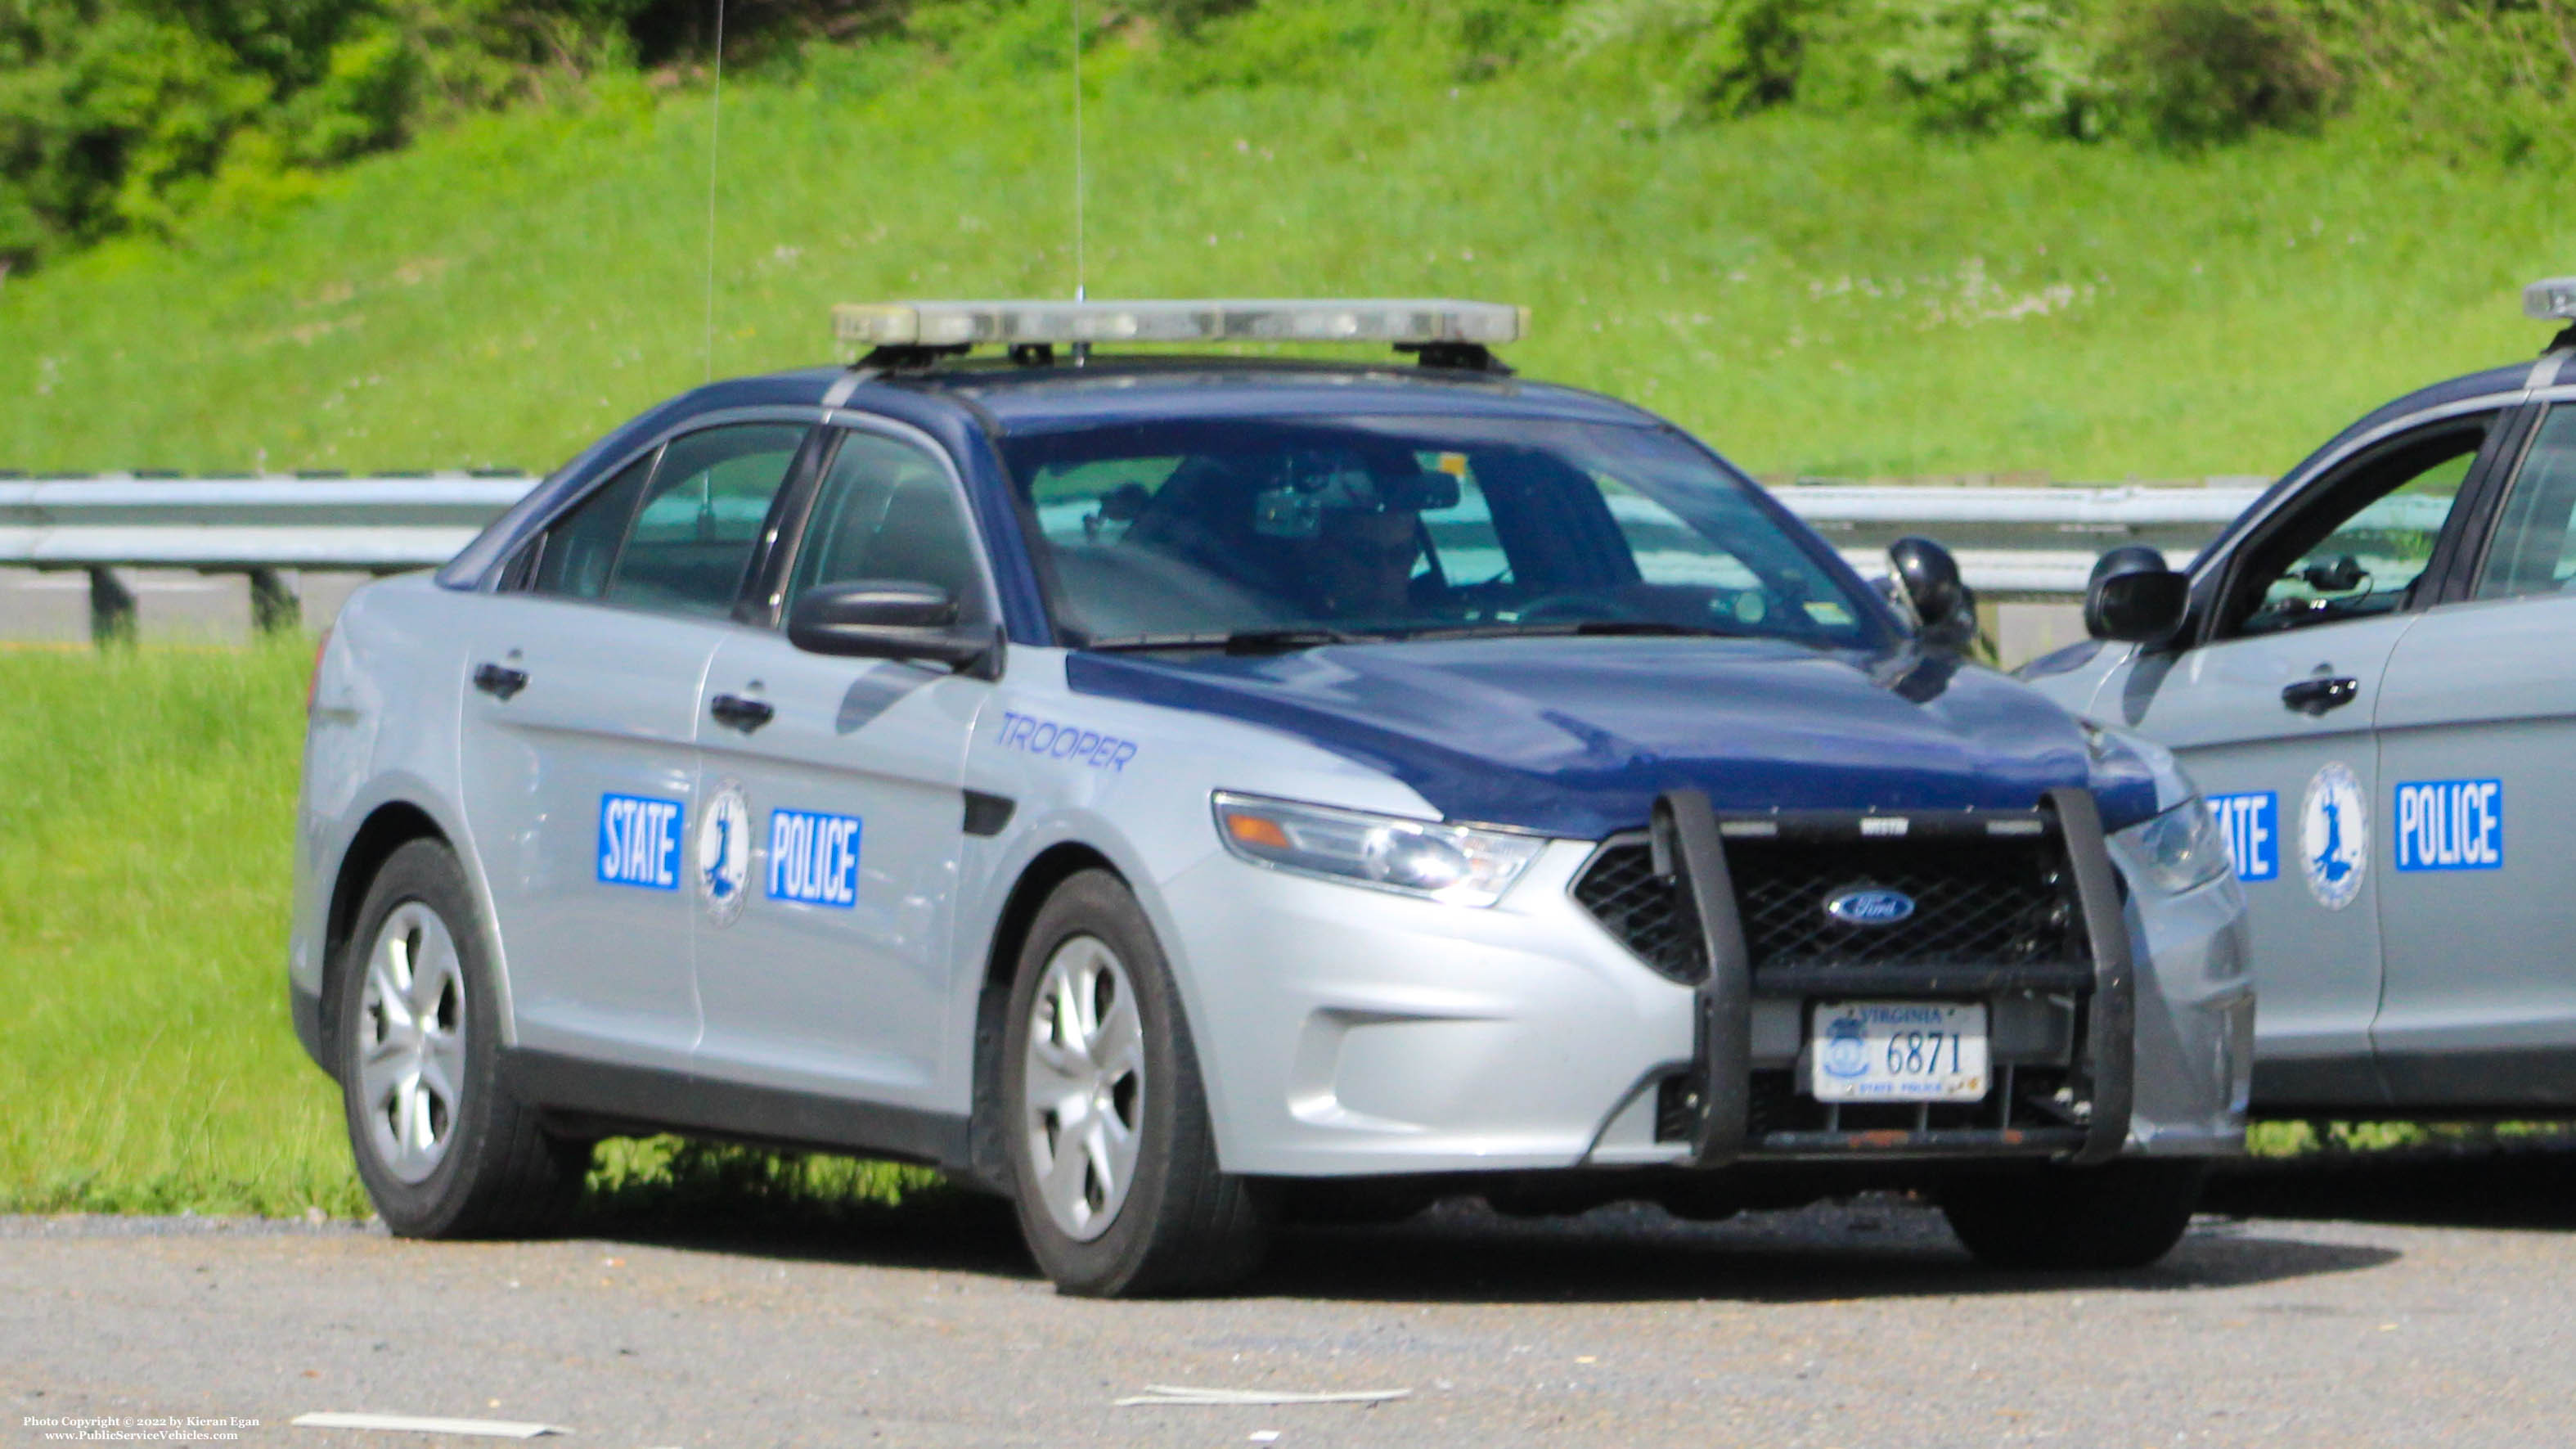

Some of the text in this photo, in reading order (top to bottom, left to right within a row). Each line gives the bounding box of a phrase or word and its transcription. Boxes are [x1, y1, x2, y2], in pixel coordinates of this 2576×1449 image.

[997, 711, 1138, 772] TROOPER
[604, 798, 677, 885] STATE
[769, 812, 858, 902] POLICE
[2399, 782, 2498, 866] POLICE
[1855, 897, 1897, 916] Ford
[1860, 1007, 1942, 1024] VIRGINIA
[1887, 1031, 1961, 1074] 6871
